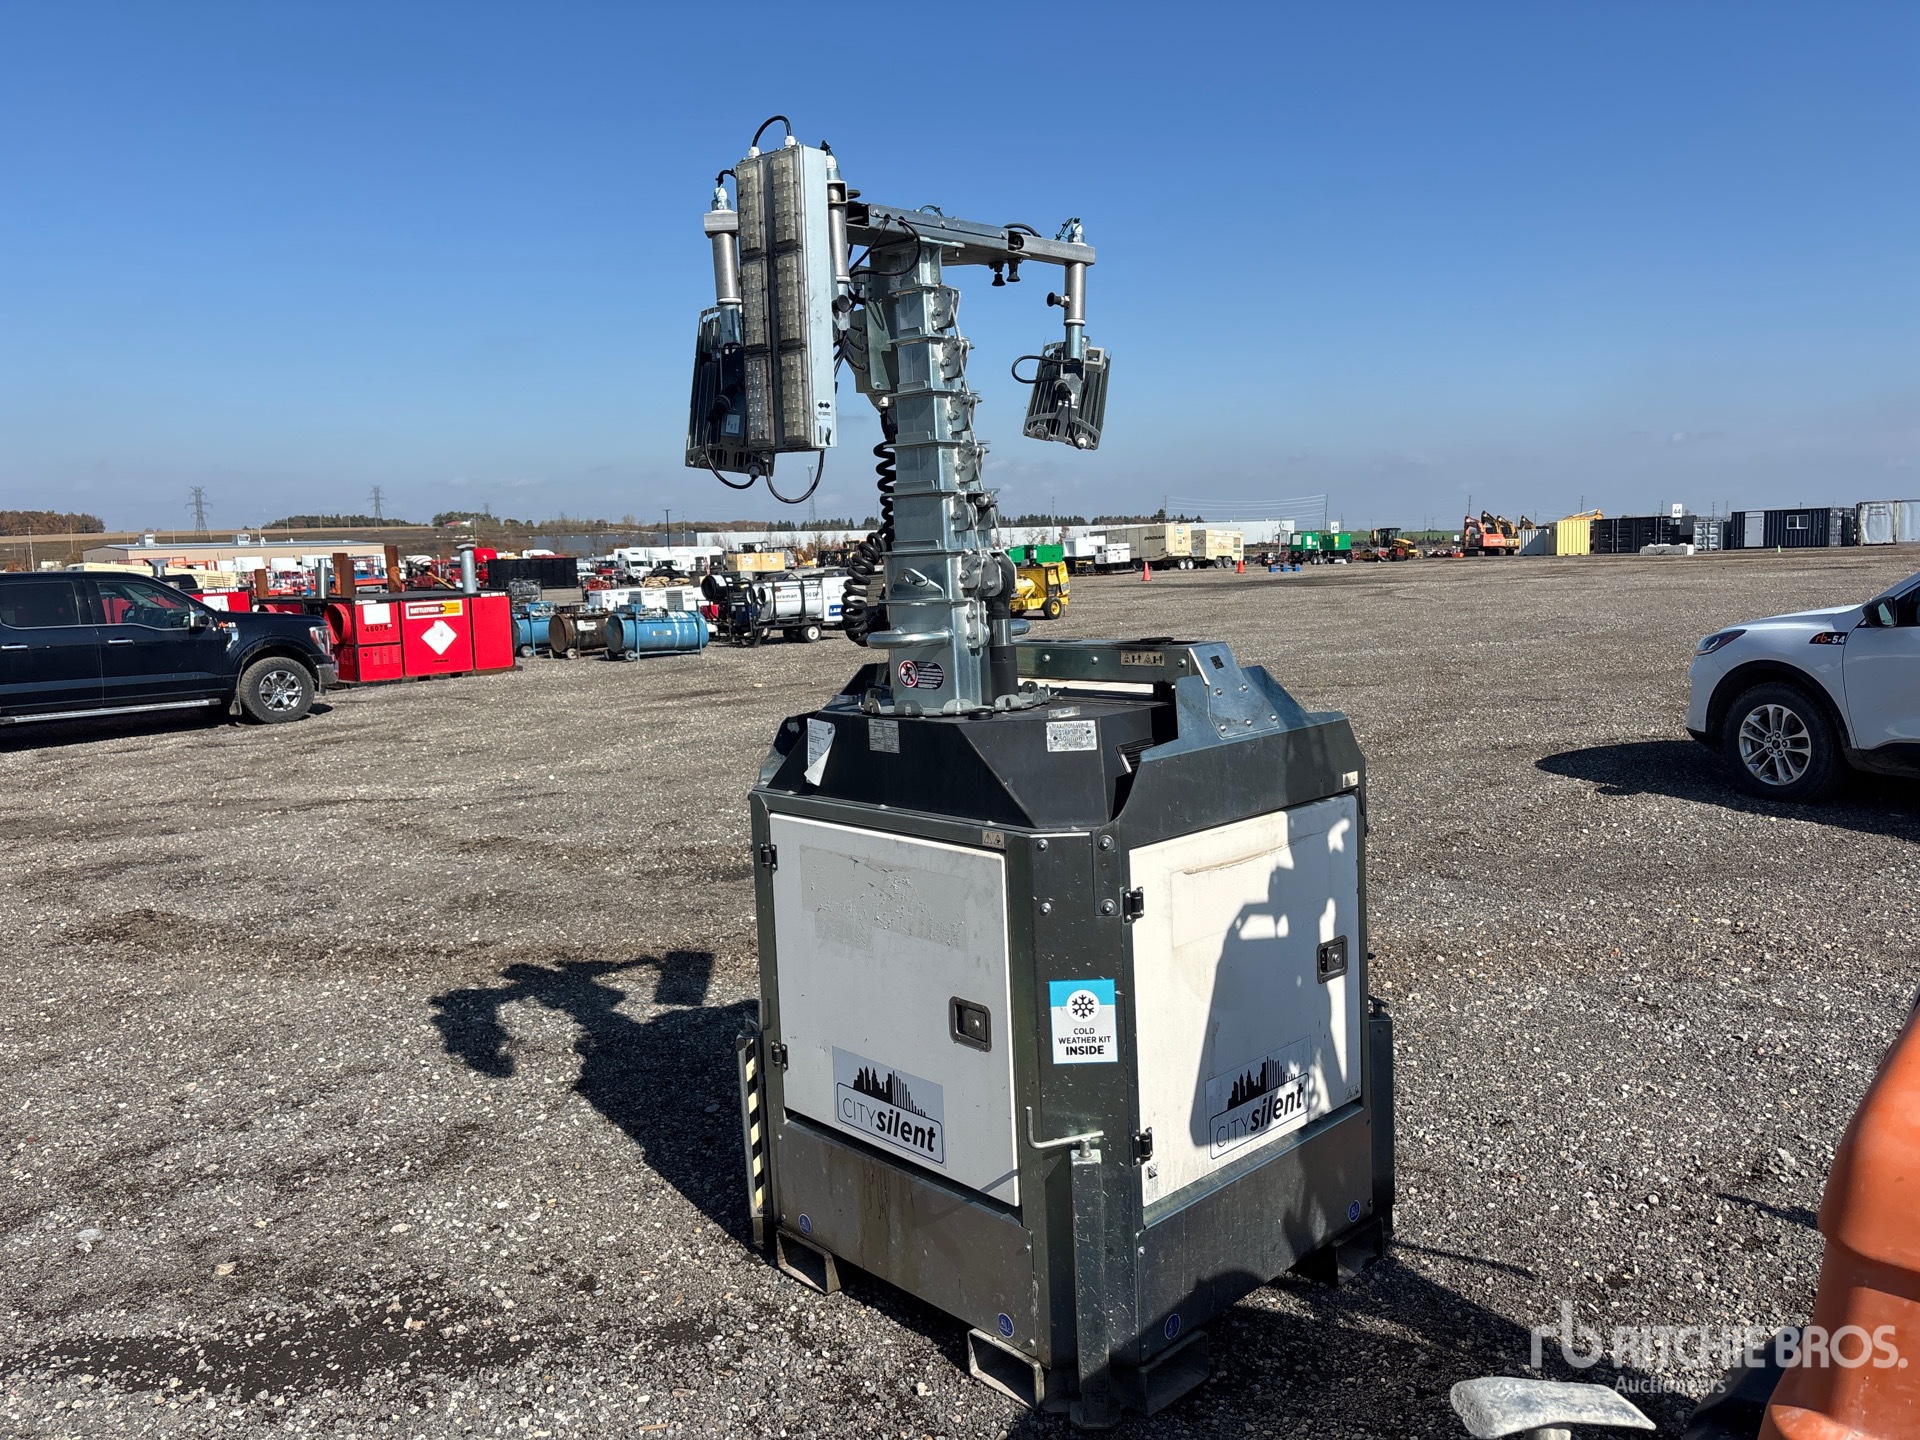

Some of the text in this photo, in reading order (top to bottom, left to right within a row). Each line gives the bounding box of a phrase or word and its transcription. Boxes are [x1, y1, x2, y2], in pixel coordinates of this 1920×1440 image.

[1815, 633, 1845, 644] rb-54
[1073, 1027, 1095, 1035] COLD
[1058, 1035, 1112, 1045] WEATHER KIT
[1065, 1045, 1105, 1056] INSIDE
